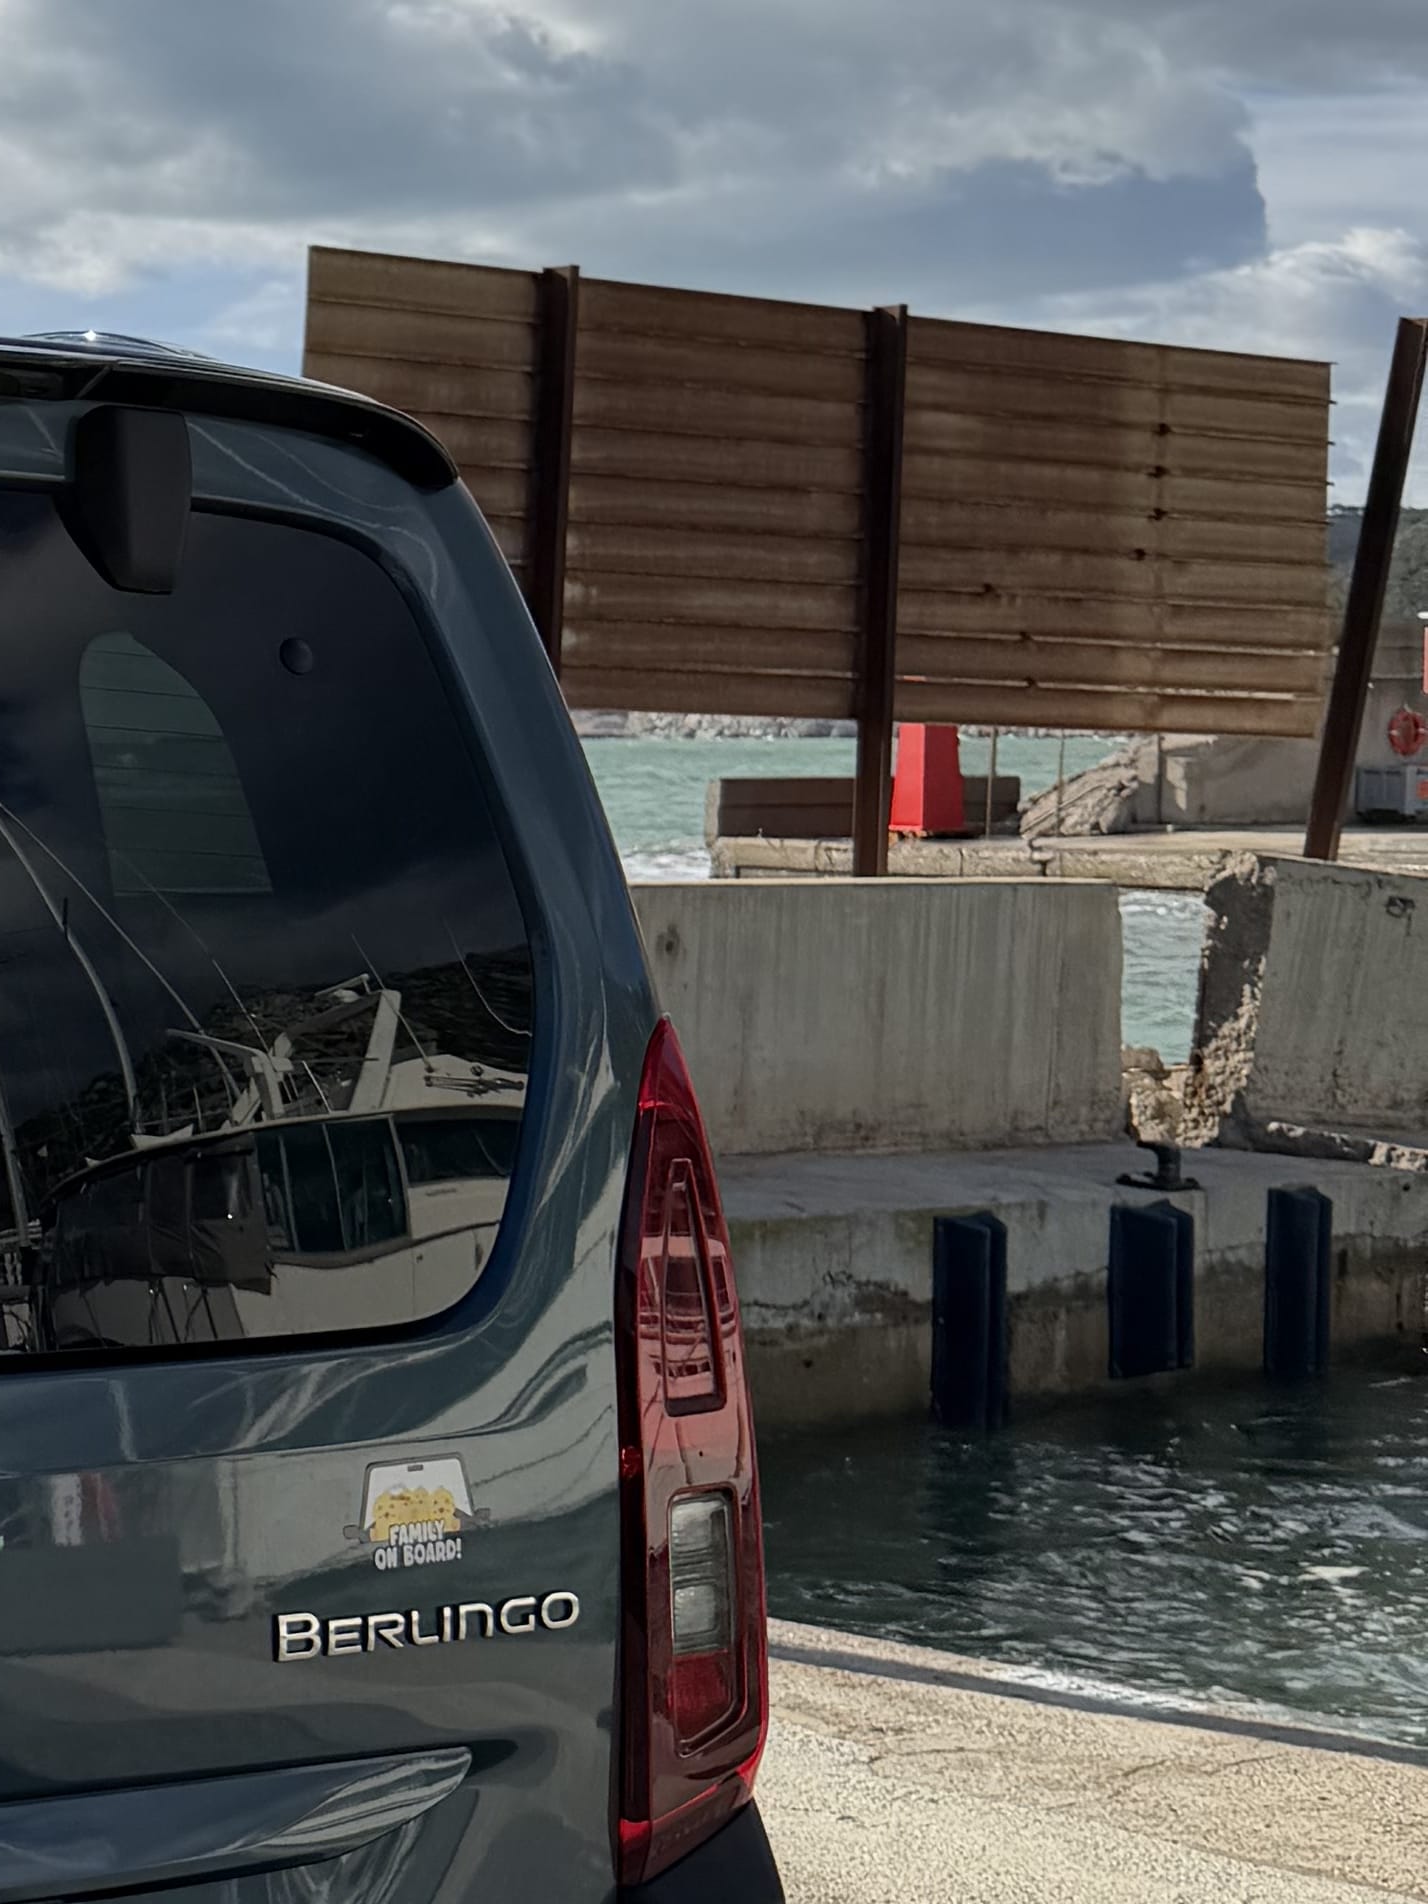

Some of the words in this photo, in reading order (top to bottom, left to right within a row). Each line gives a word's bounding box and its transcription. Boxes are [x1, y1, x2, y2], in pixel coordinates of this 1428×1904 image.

[390, 1519, 444, 1546] FAMILY
[374, 1547, 398, 1570] ON
[402, 1537, 462, 1567] BOARD!
[275, 1591, 580, 1662] BERLINGO
